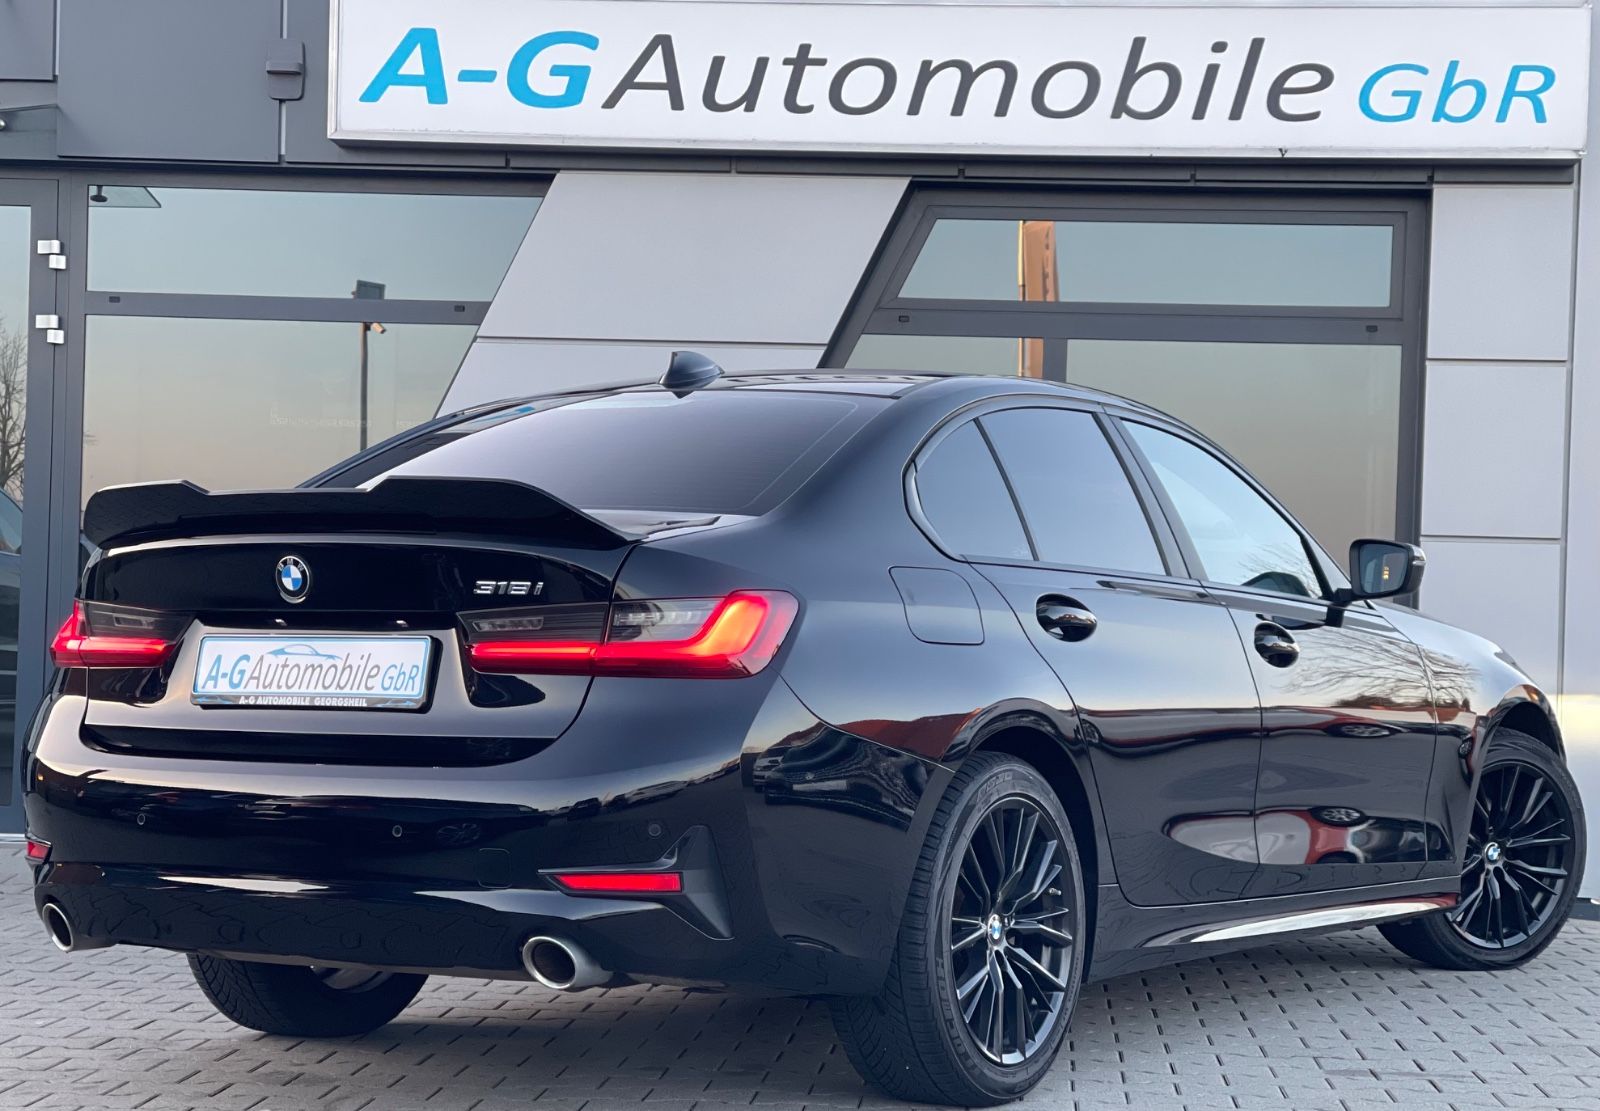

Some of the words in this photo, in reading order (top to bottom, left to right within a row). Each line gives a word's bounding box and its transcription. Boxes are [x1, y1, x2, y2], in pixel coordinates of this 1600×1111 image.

[358, 27, 600, 109] A-G
[600, 33, 1335, 122] Automobile
[1358, 60, 1557, 124] GbR
[201, 653, 251, 690] A-G
[244, 652, 381, 692] Automobile
[380, 662, 420, 693] GbR
[238, 695, 256, 705] A-G
[256, 696, 311, 706] AUTOMOBILE
[314, 697, 368, 707] GEORGSHEIL
